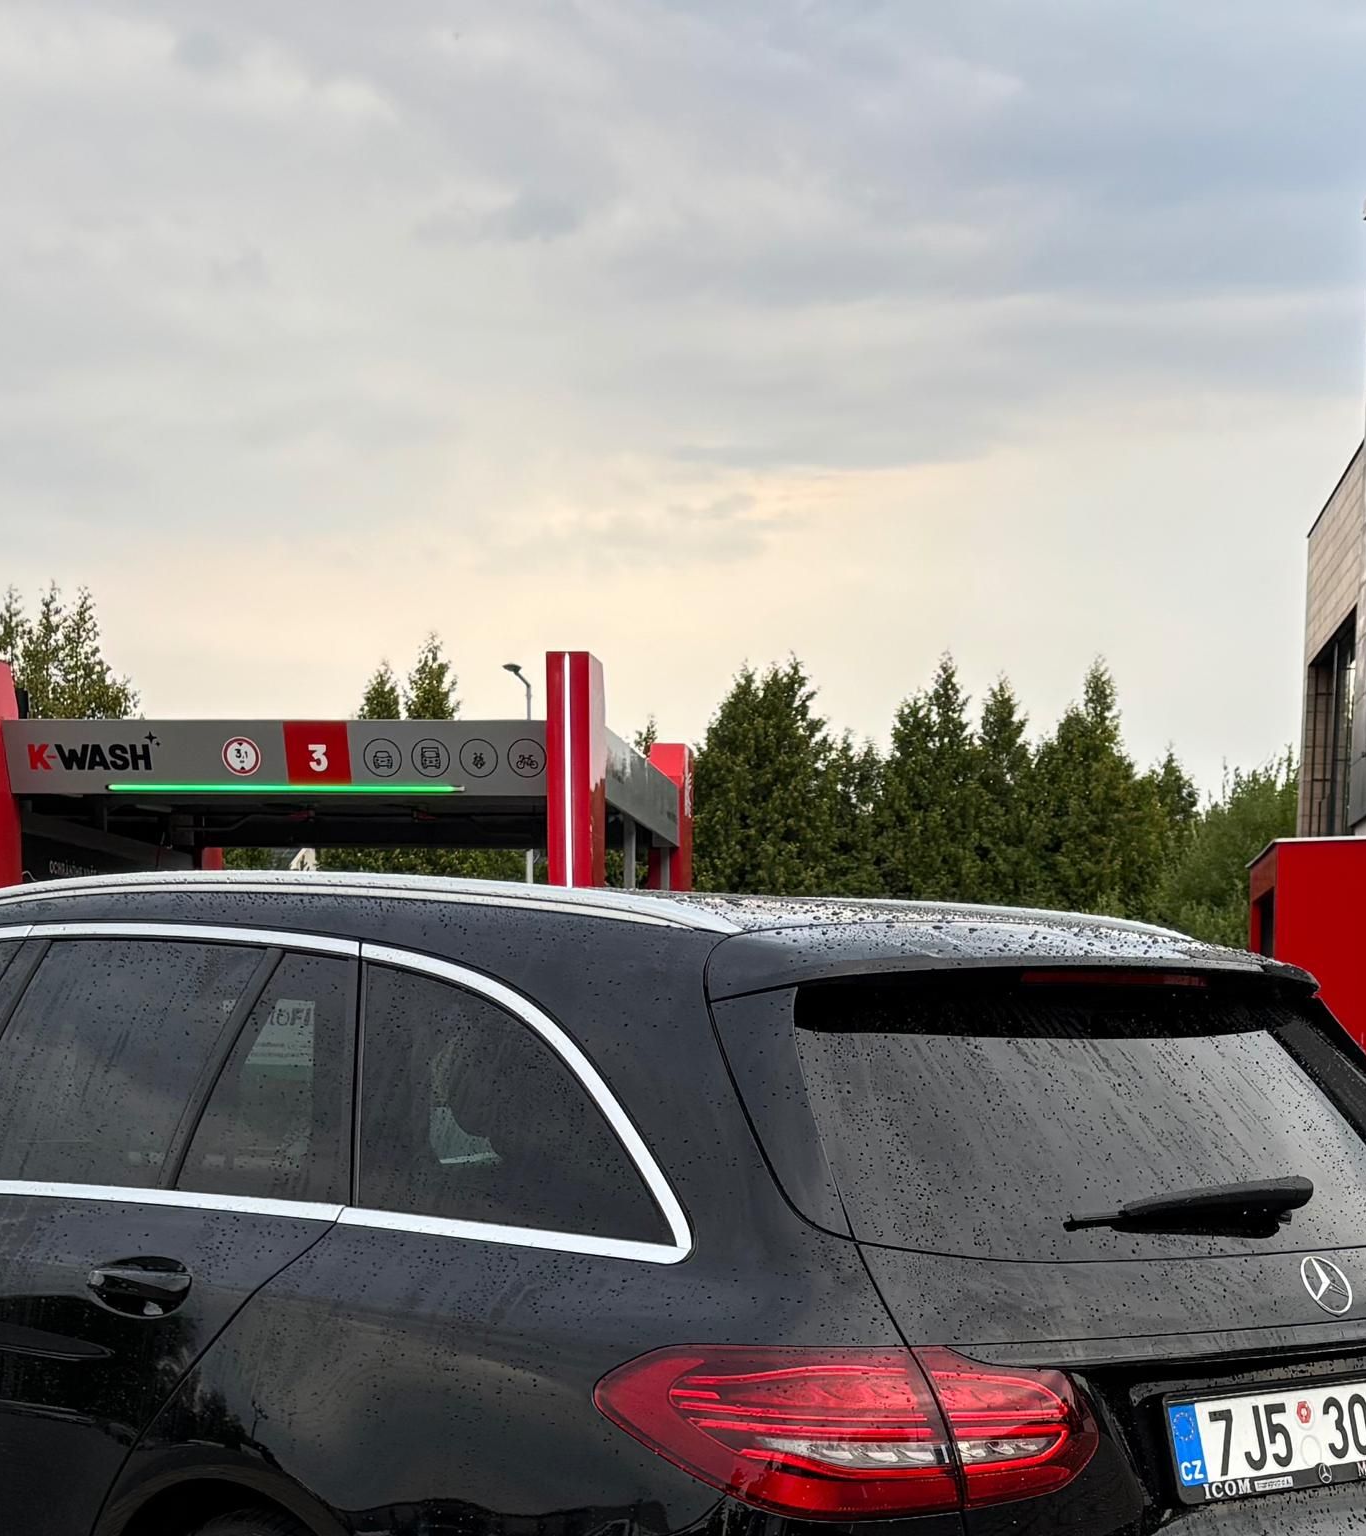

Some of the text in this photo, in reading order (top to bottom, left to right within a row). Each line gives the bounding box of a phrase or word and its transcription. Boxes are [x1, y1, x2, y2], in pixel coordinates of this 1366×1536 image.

[28, 743, 153, 771] K-WASH
[307, 744, 329, 772] 3
[1208, 1402, 1293, 1477] 7J5
[1181, 1461, 1204, 1481] CZ
[1203, 1478, 1252, 1500] ICOM
